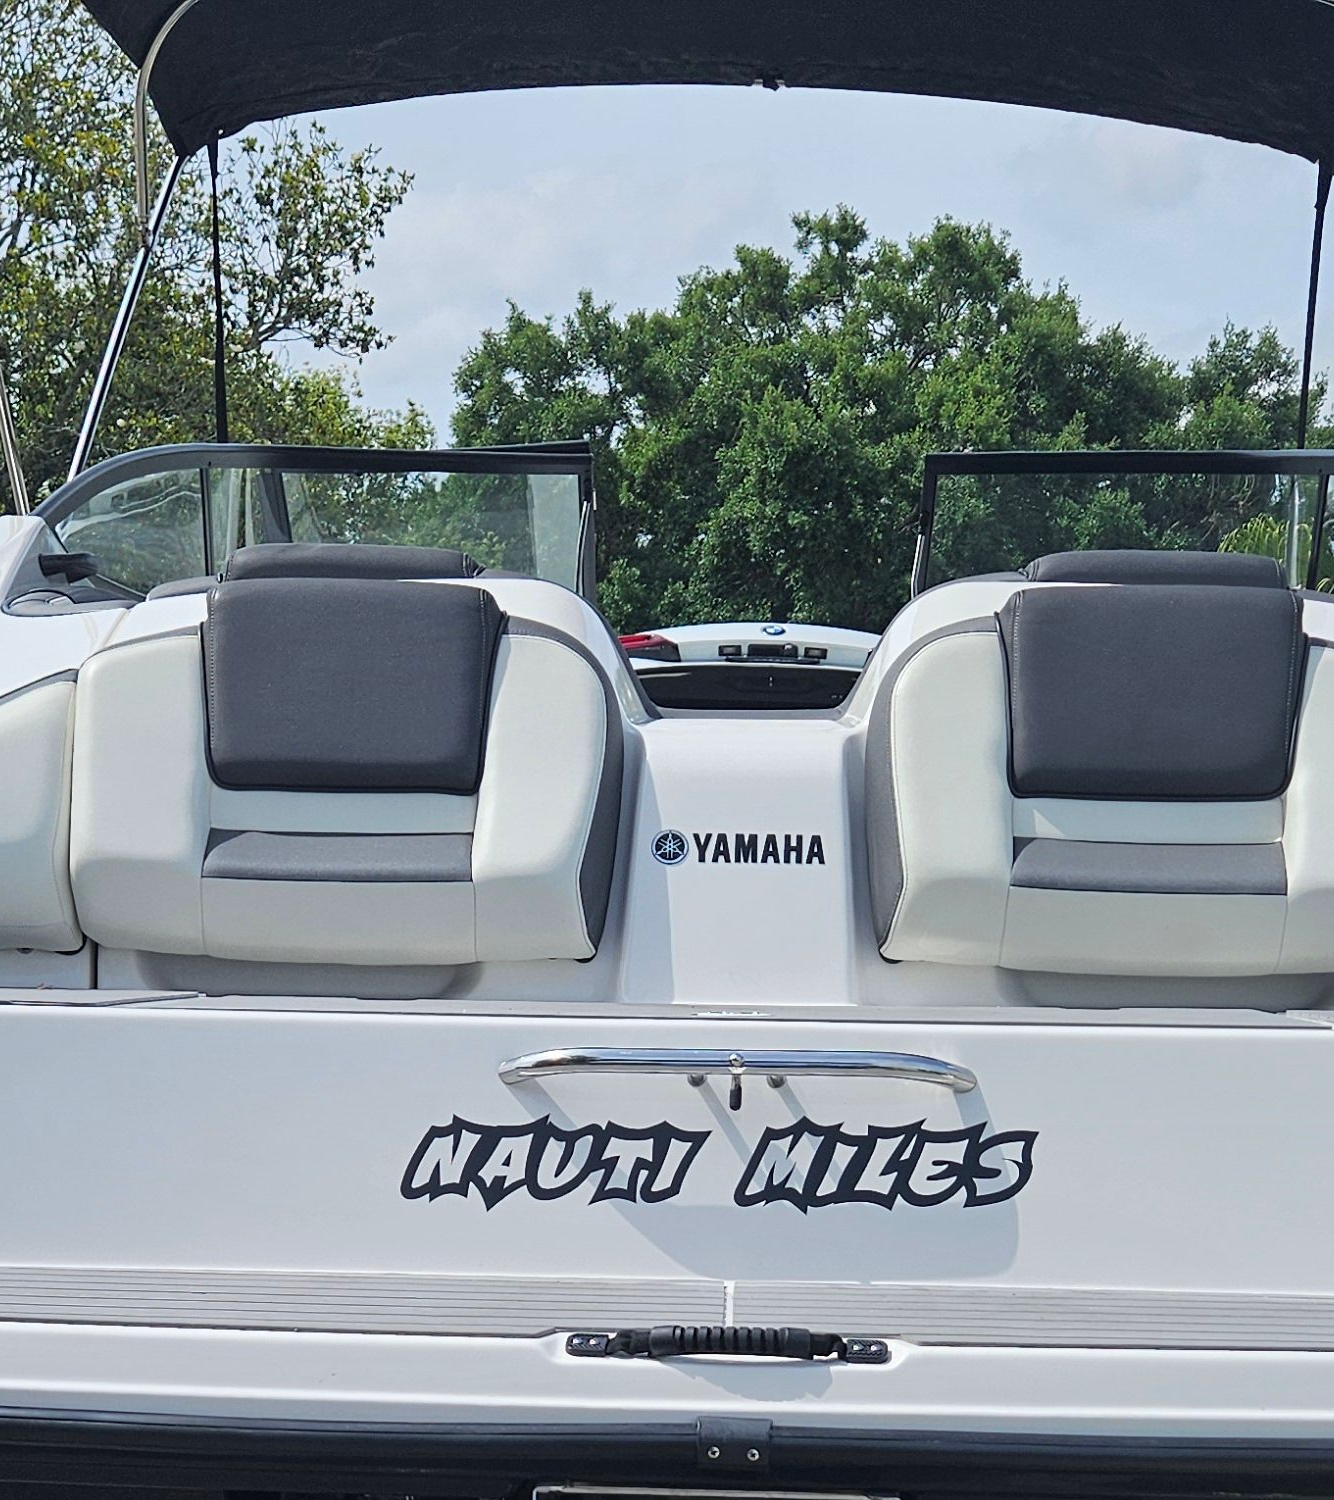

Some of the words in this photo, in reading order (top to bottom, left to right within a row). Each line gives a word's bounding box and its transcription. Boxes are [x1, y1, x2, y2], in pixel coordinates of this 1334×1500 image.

[693, 833, 825, 864] YAMAHA
[400, 1115, 711, 1210] NAUTI
[734, 1116, 1039, 1214] MILES
